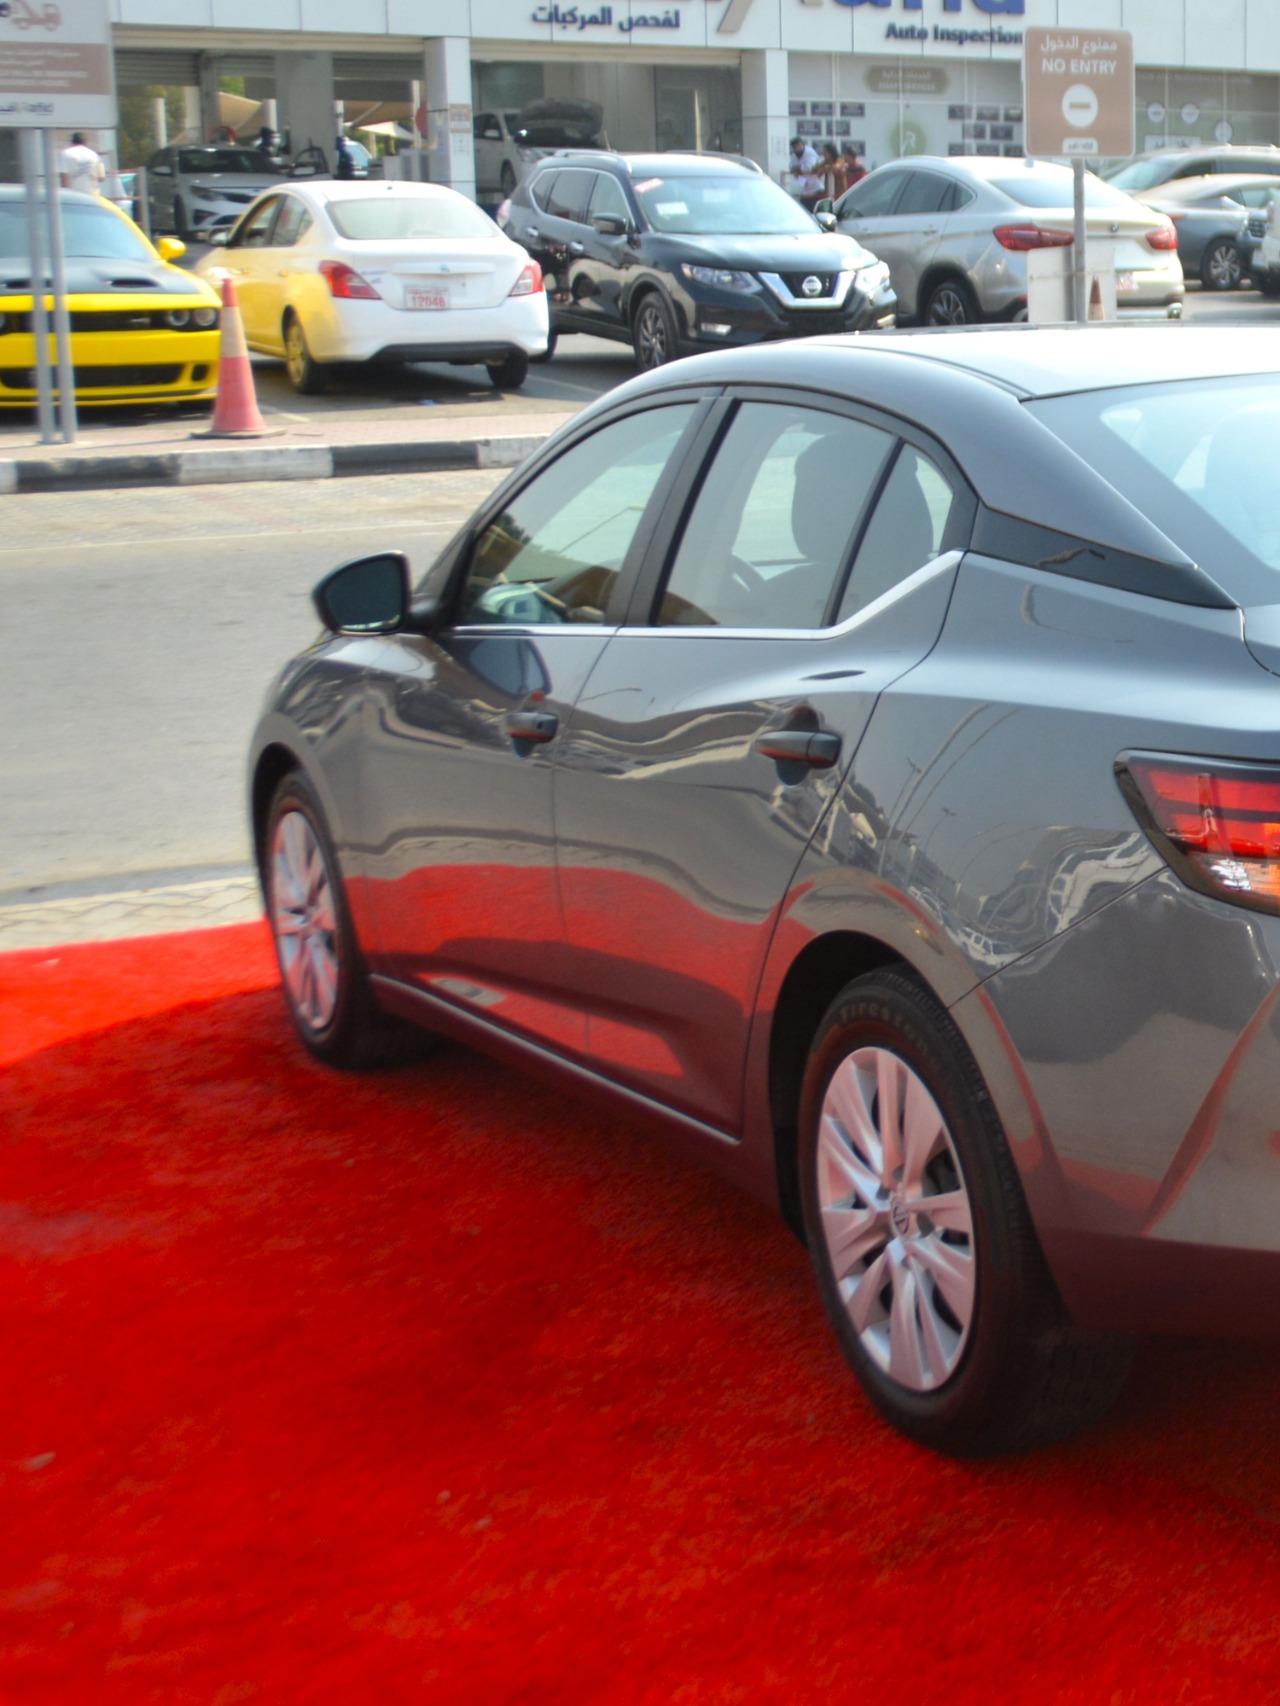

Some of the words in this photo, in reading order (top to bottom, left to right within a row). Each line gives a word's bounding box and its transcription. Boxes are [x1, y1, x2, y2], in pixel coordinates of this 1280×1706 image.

[531, 4, 613, 30] المركبات
[618, 9, 681, 32] لفحص
[885, 22, 929, 41] Auto
[933, 24, 1024, 45] Inspection
[1040, 33, 1079, 53] الدخول
[1082, 36, 1118, 56] ممنوع
[1041, 58, 1066, 74] NO
[1070, 59, 1118, 75] ENTRY
